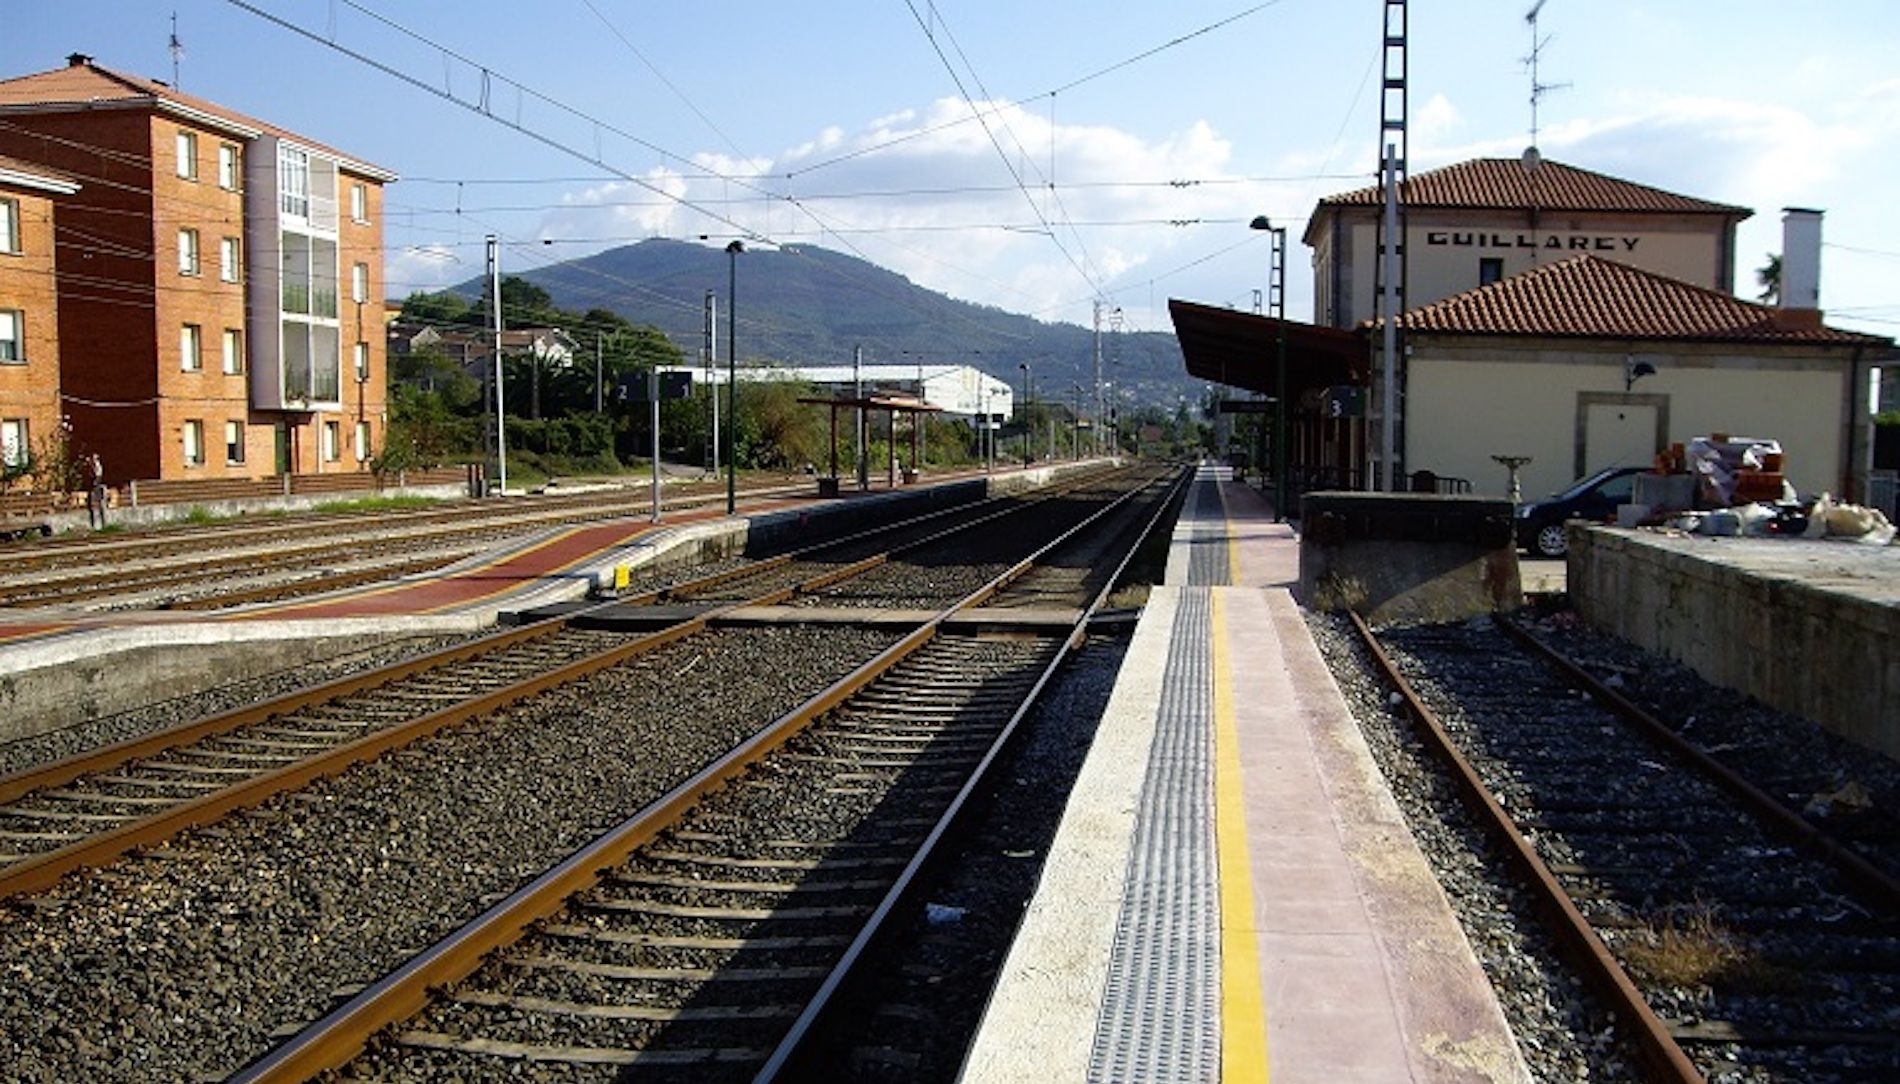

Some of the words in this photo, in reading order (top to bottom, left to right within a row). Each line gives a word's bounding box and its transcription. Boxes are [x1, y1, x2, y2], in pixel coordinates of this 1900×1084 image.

[1427, 231, 1640, 251] GUILLAREY
[618, 384, 628, 400] 2
[681, 383, 690, 397] 1
[1332, 399, 1343, 417] 3
